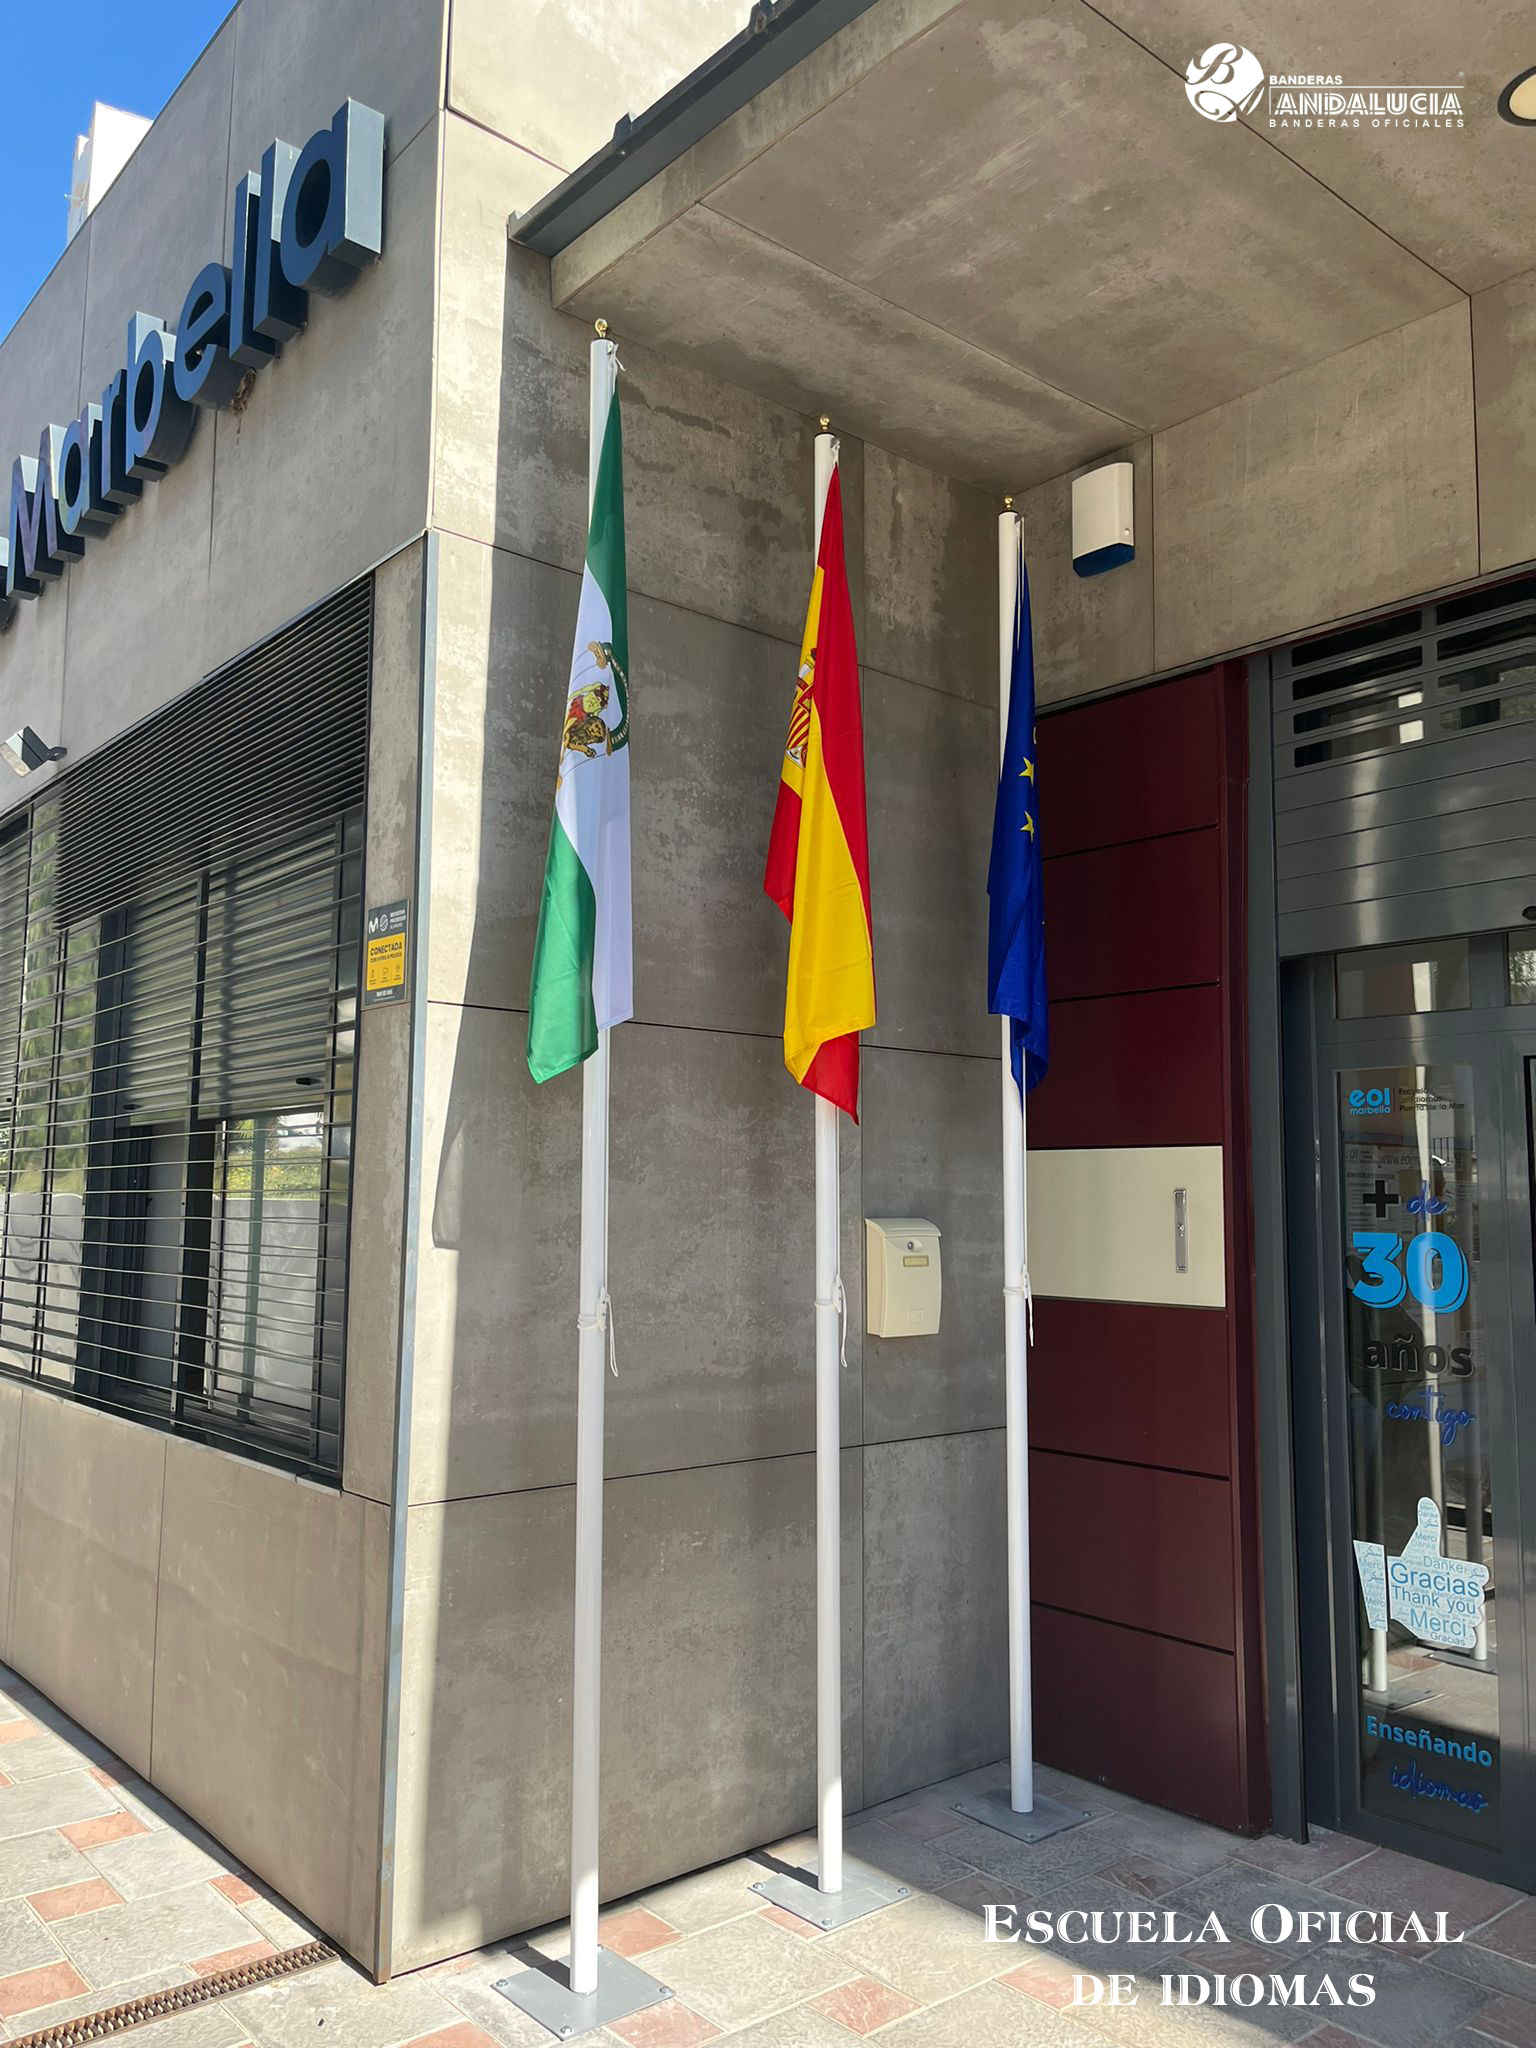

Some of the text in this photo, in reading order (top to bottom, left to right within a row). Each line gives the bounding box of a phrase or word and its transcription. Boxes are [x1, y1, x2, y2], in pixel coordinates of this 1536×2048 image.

[6, 97, 385, 600] Marbella
[370, 941, 403, 957] CONECTADA
[1350, 1106, 1391, 1115] marbella
[1407, 1180, 1448, 1221] de
[1353, 1232, 1469, 1314] 30
[1363, 1335, 1475, 1377] años
[1385, 1385, 1475, 1446] contigo
[1391, 1563, 1480, 1598] Gracias
[1423, 1556, 1464, 1573] Danke
[1392, 1584, 1440, 1608] Thank
[1447, 1599, 1476, 1614] you
[1410, 1608, 1466, 1637] Merci
[1430, 1631, 1466, 1646] Gracias
[1366, 1715, 1493, 1768] Enseñando
[1390, 1761, 1489, 1814] idiomas
